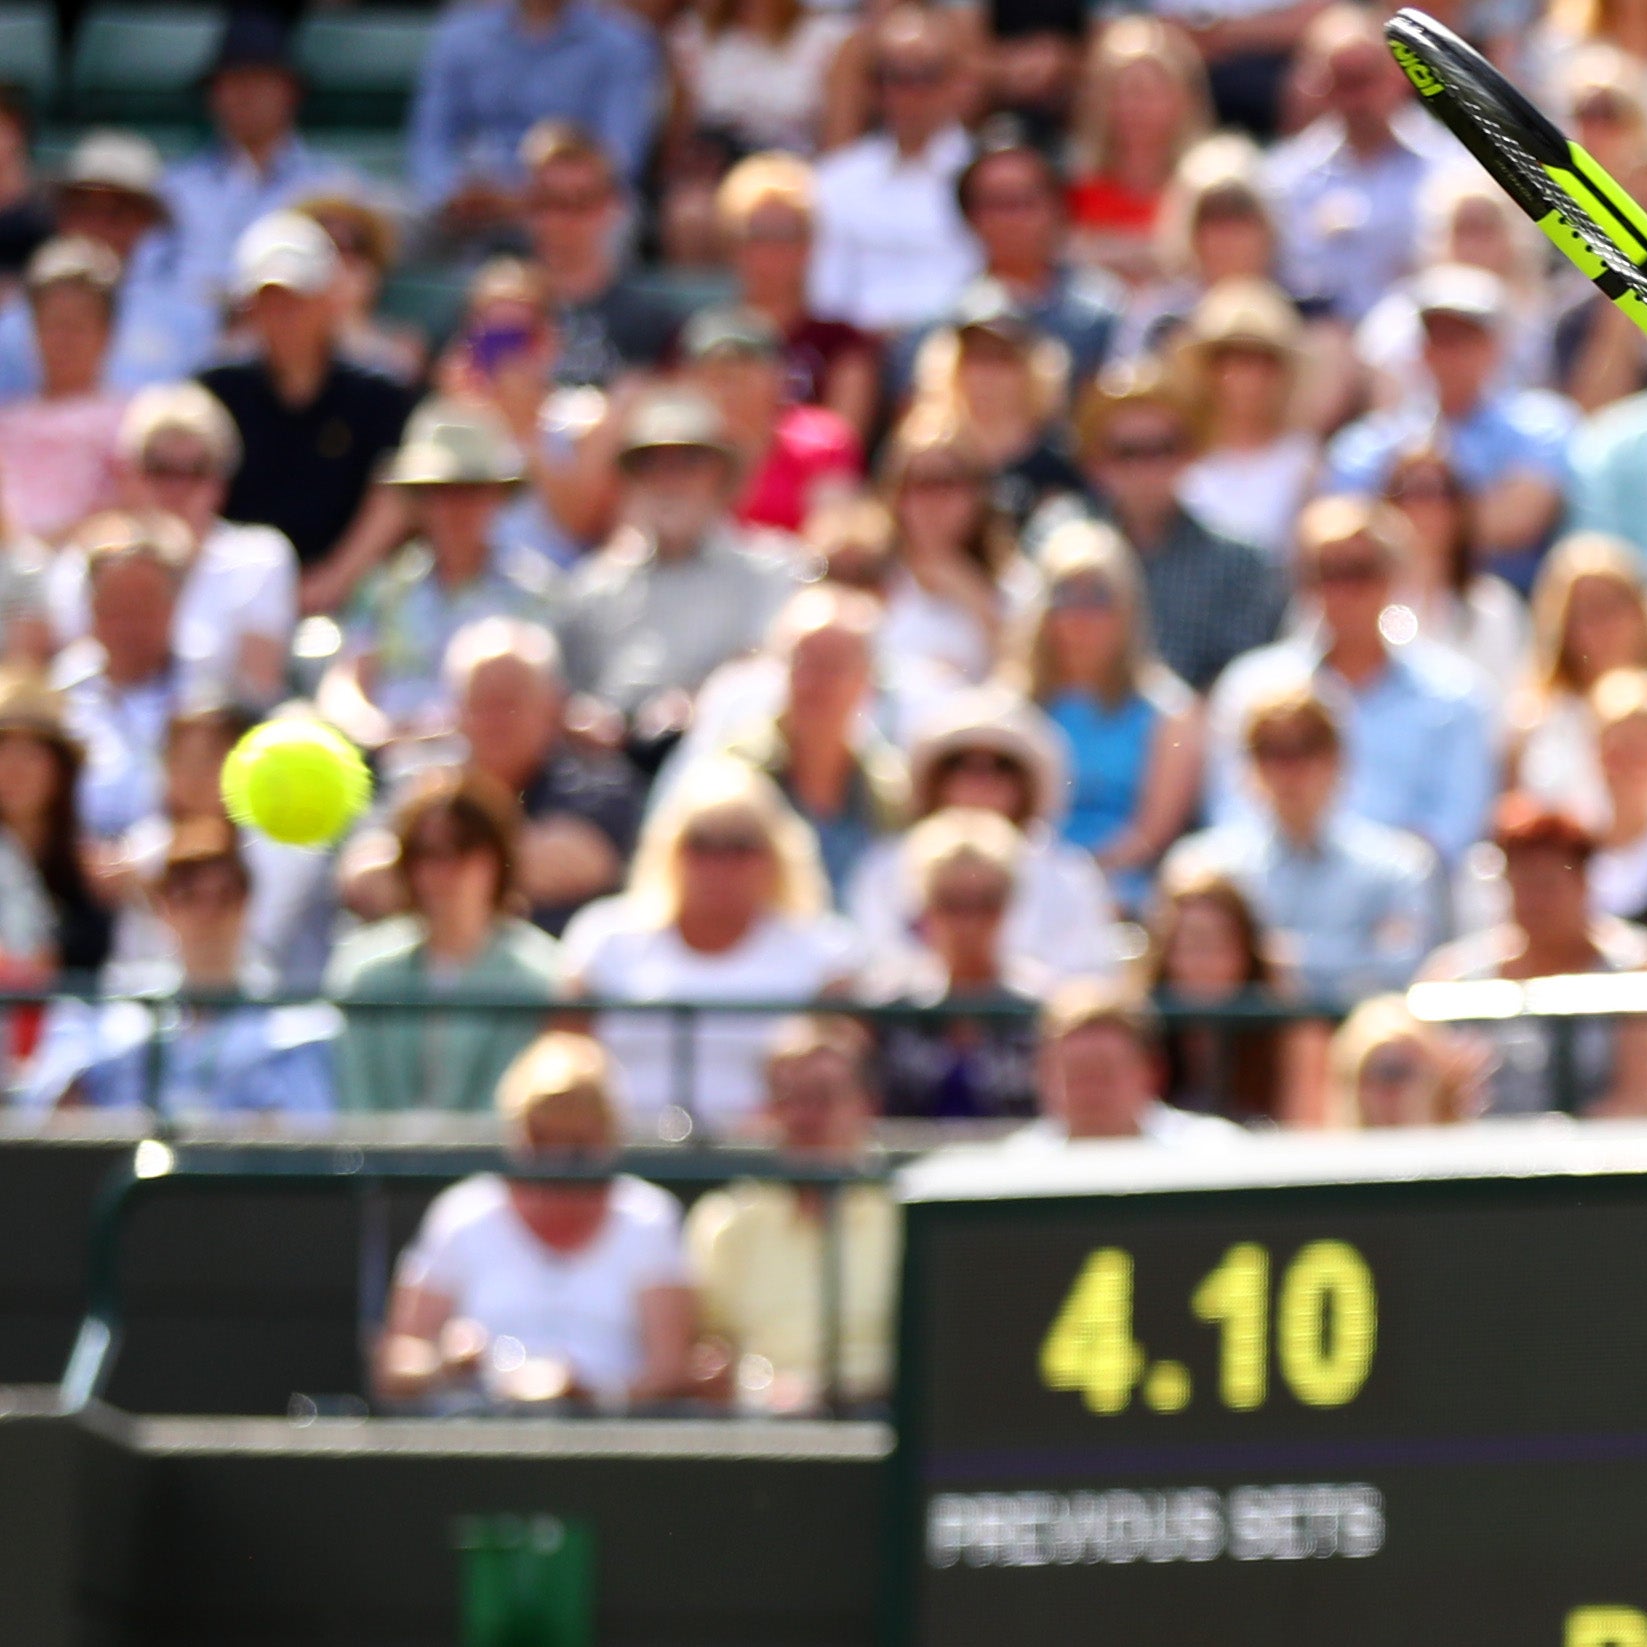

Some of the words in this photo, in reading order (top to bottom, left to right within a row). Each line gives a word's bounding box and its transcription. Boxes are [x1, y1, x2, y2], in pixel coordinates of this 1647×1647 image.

[1042, 1241, 1378, 1413] 4.10
[927, 1490, 1226, 1568] PREVIOUS
[1227, 1482, 1387, 1562] SETS
